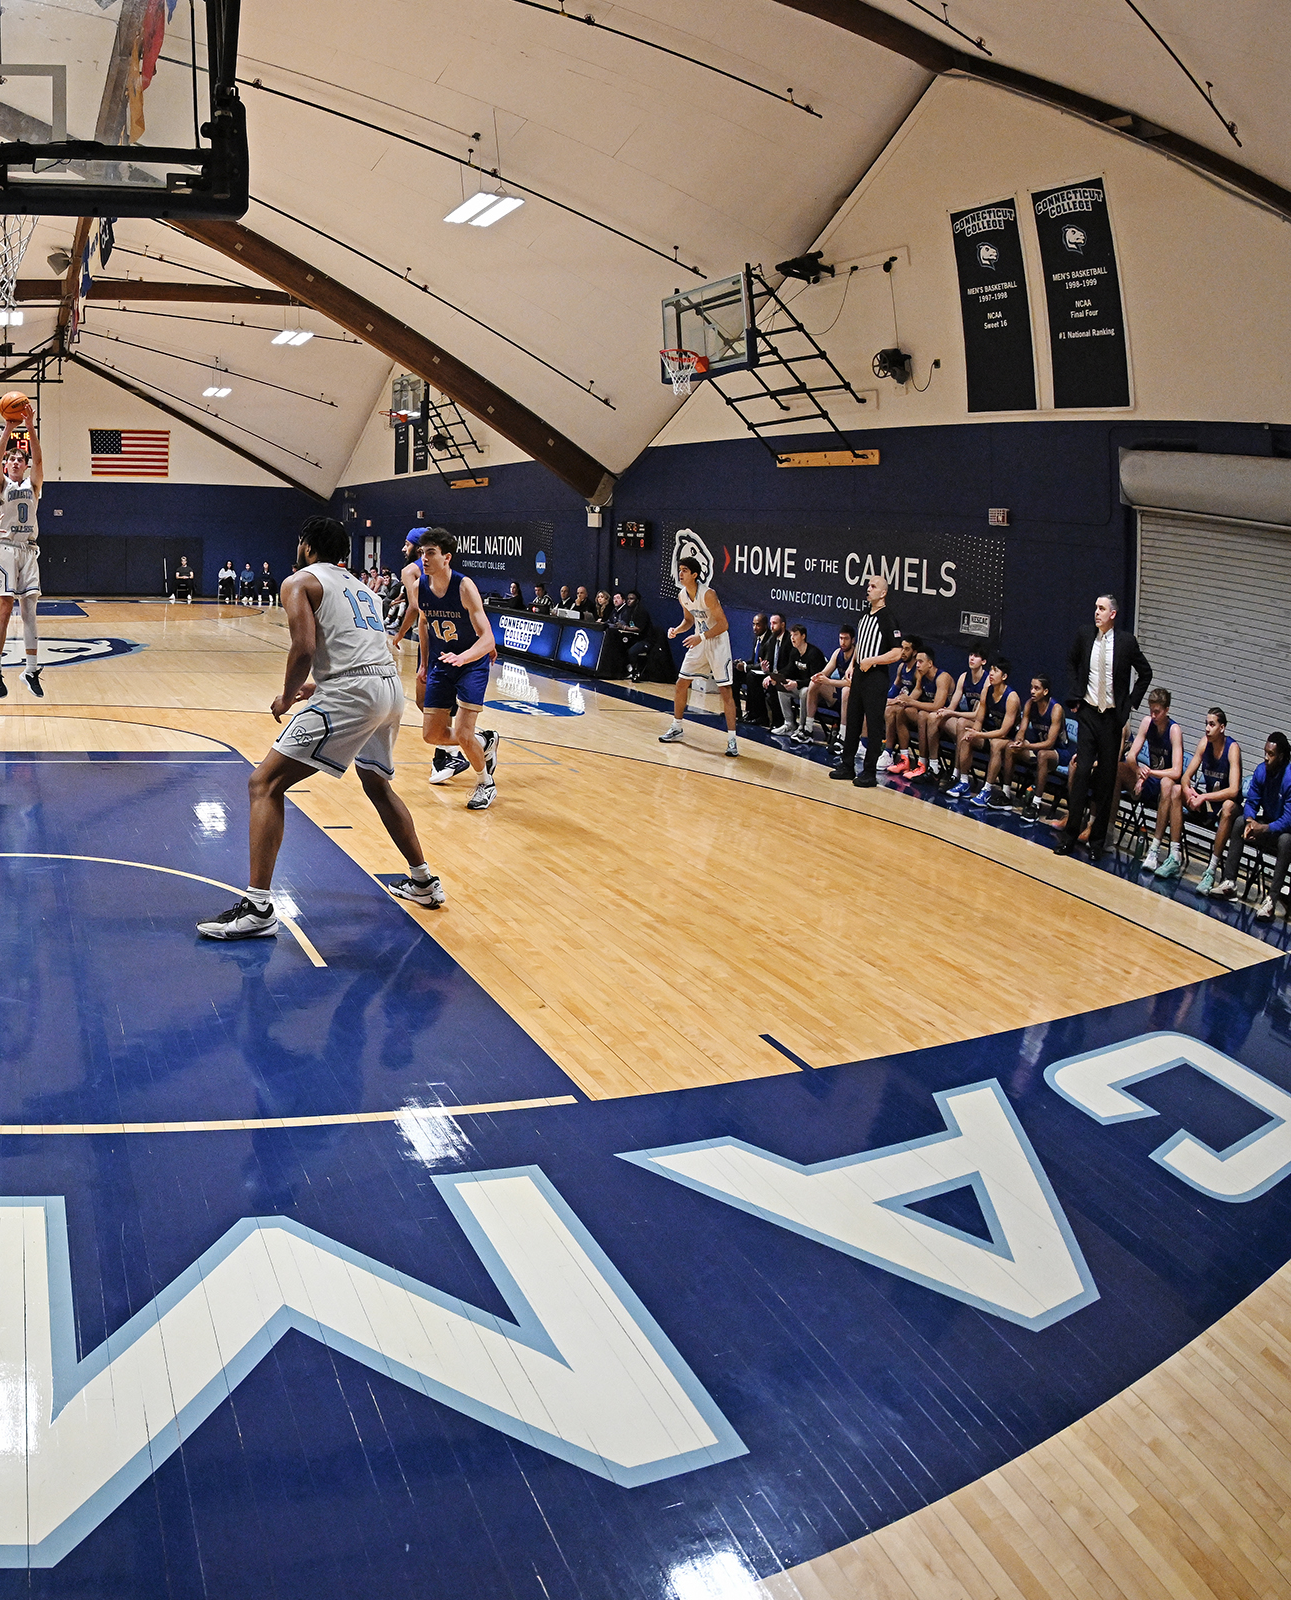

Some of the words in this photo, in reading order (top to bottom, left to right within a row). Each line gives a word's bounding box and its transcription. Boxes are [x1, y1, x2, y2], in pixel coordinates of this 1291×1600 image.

[1035, 188, 1103, 214] CONNECTICUT
[1048, 200, 1092, 218] COLLEGE
[953, 208, 1015, 233] CONNECTICUT
[965, 219, 1004, 237] COLLEGE
[1052, 272, 1070, 282] MEN'S
[1071, 267, 1108, 279] BASKETBALL
[967, 287, 984, 296] MEN'S
[984, 281, 1018, 293] BASKETBALL
[1065, 279, 1097, 290] 1998-1999
[978, 292, 1008, 303] 1997-1998
[1075, 299, 1092, 308] NCAA
[987, 311, 1003, 319] NCAA
[1070, 310, 1085, 319] Final
[1086, 309, 1099, 317] Four
[984, 321, 999, 330] Sweet
[1000, 319, 1008, 327] 16
[1068, 329, 1091, 339] National
[1092, 328, 1115, 337] Ranking
[17, 502, 28, 523] 0
[453, 535, 482, 554] AMEL
[484, 536, 523, 556] NATION
[462, 560, 487, 569] CONNECTICUT
[487, 562, 506, 571] COLLEGE
[735, 544, 797, 579] HOME
[804, 557, 817, 572] OF
[820, 559, 839, 574] THE
[844, 552, 957, 598] CAMELS
[770, 588, 833, 608] CONNECTICUT
[835, 596, 870, 612] COLLE
[343, 587, 384, 632] 13
[431, 620, 458, 642] 12
[499, 615, 544, 636] CONNECTICUT
[505, 628, 532, 643] COLLEGE
